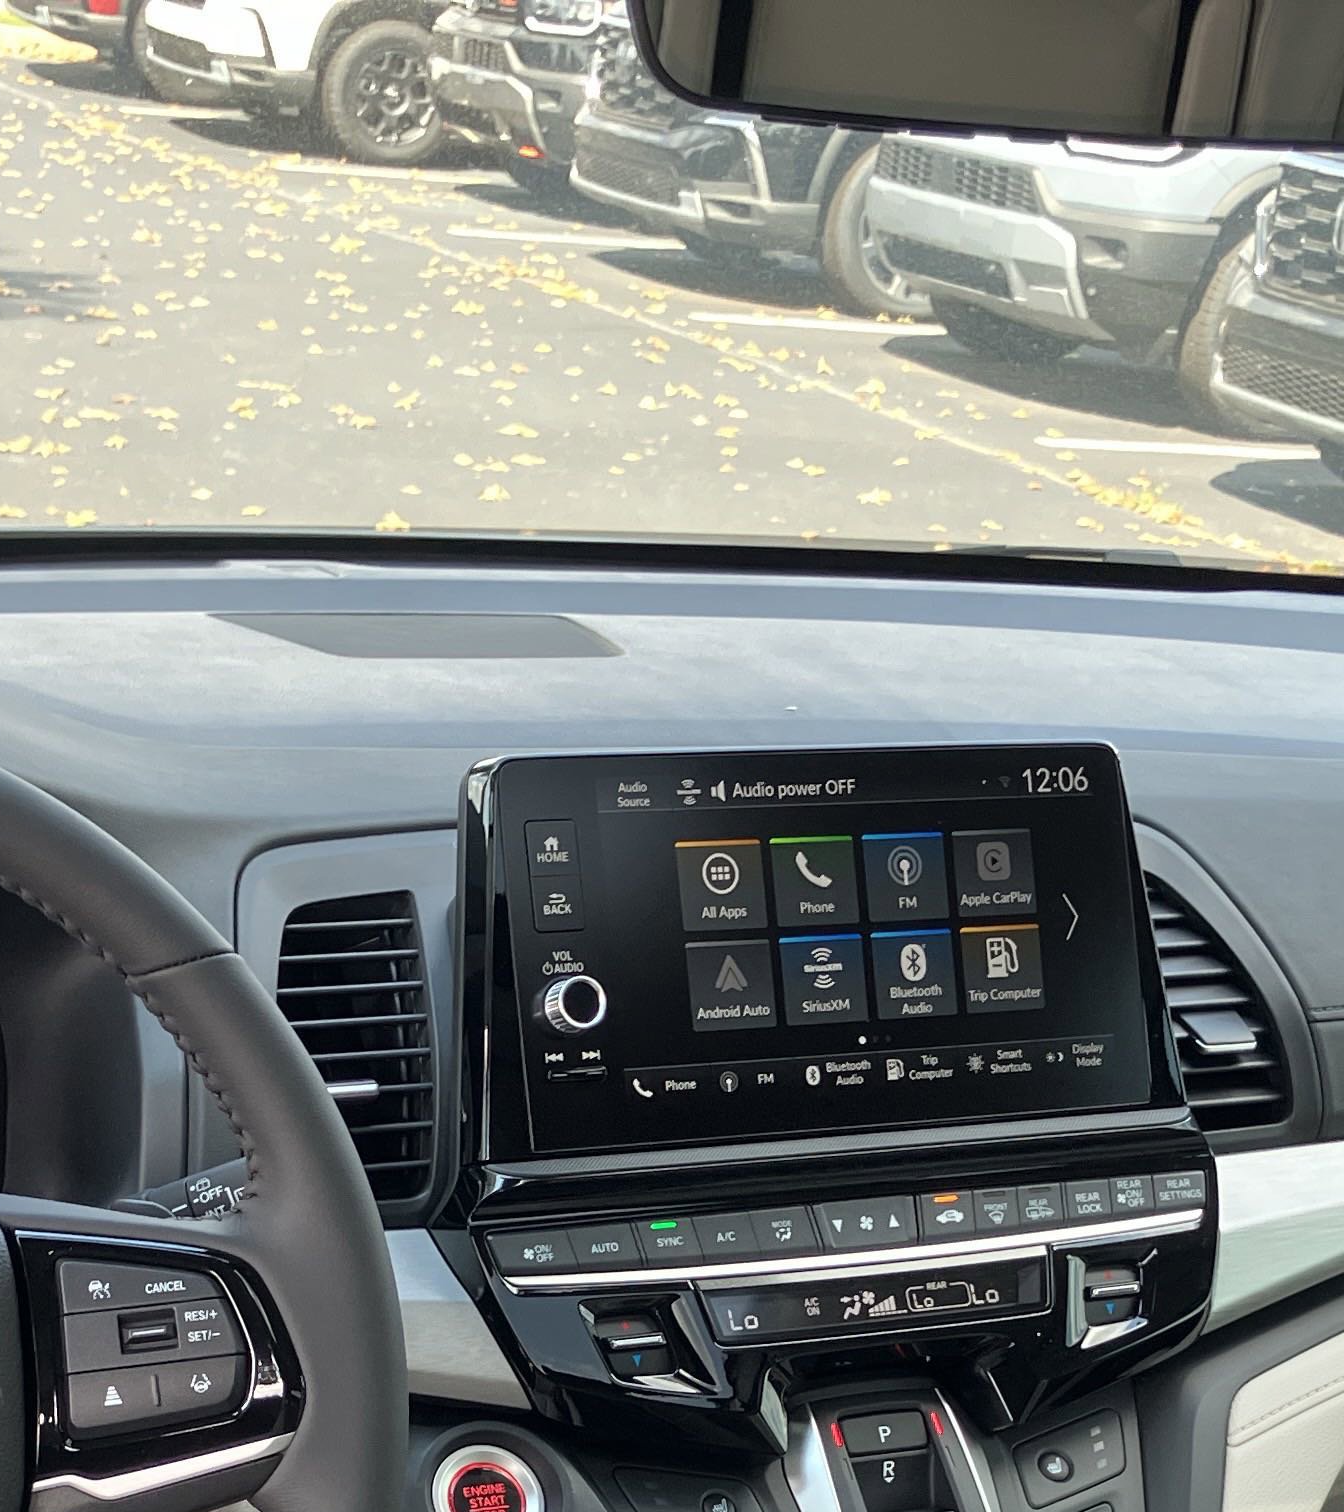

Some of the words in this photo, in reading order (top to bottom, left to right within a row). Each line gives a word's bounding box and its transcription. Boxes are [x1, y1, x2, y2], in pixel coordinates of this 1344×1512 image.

[1022, 766, 1089, 793] 12:06
[617, 781, 648, 794] Audio
[732, 782, 774, 798] Audio
[777, 784, 822, 801] power
[825, 778, 856, 796] OFF
[617, 796, 650, 808] Source
[536, 851, 569, 864] HOME
[898, 897, 917, 909] FM
[960, 893, 991, 908] Apple
[992, 891, 1032, 905] CarPlay
[543, 903, 573, 916] BACK
[701, 906, 717, 919] All
[719, 906, 747, 921] Apps
[799, 901, 835, 915] Phone
[552, 951, 573, 962] VOL
[553, 962, 584, 974] AUDIO
[890, 984, 943, 999] Bluetooth
[968, 989, 989, 1003] Trip
[990, 987, 1042, 1002] Computer
[696, 1005, 740, 1020] Android
[743, 1004, 770, 1017] Auto
[802, 998, 850, 1013] SiriusXM
[902, 1003, 933, 1015] Audio
[996, 1049, 1023, 1061] Smart
[1072, 1042, 1104, 1056] Display
[825, 1059, 871, 1073] Bluetooth
[921, 1054, 938, 1067] Trip
[1076, 1056, 1102, 1068] Mode
[757, 1073, 774, 1085] FM
[836, 1074, 864, 1087] Audio
[909, 1067, 953, 1082] Computer
[665, 1079, 697, 1092] Phone
[1116, 1179, 1142, 1190] REAR
[1166, 1178, 1190, 1189] REAR
[199, 1185, 224, 1203] OFF
[1074, 1191, 1100, 1203] REAR
[1125, 1189, 1143, 1199] ON/
[1159, 1188, 1202, 1201] SETTINGS
[1077, 1203, 1103, 1215] LOCK
[1127, 1198, 1145, 1208] OFF
[771, 1220, 793, 1229] MODE
[656, 1236, 684, 1248] SYNC
[716, 1231, 737, 1243] A/C
[534, 1244, 552, 1255] ON/
[591, 1242, 619, 1255] AUTO
[536, 1252, 555, 1263] OFF
[145, 1280, 186, 1295] CANCEL
[913, 1293, 934, 1309] Lo
[969, 1284, 1000, 1306] Lo
[804, 1297, 819, 1308] A/C
[184, 1309, 218, 1323] RES/+
[806, 1305, 821, 1317] ON
[727, 1309, 759, 1331] Lo
[877, 1425, 892, 1443] P
[882, 1460, 895, 1477] R
[462, 1482, 507, 1498] ENGINE
[469, 1495, 505, 1508] START
